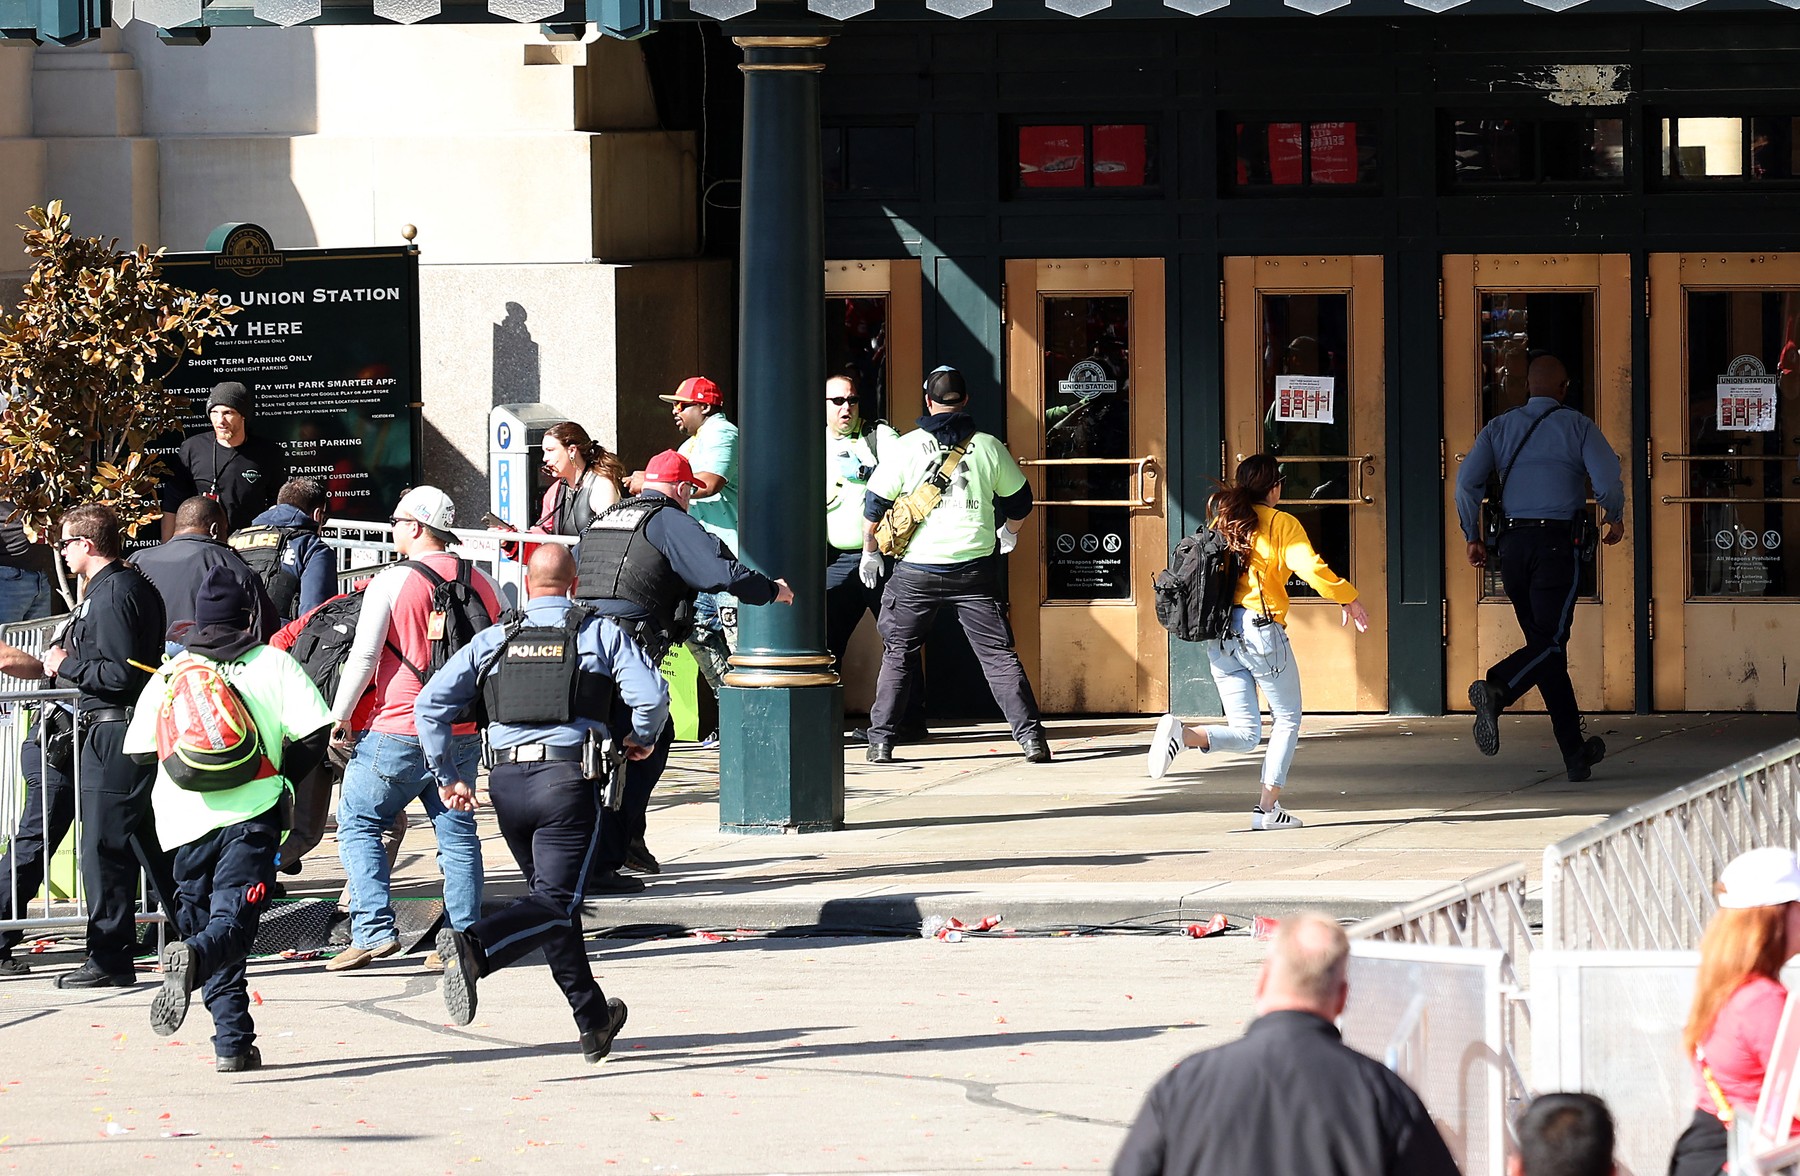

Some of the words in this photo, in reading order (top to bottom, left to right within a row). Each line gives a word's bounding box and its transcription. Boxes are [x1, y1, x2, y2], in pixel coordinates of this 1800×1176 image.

[217, 258, 243, 266] UNION
[245, 256, 280, 265] STATION
[240, 291, 305, 306] UNION
[312, 287, 400, 303] STATION
[247, 321, 303, 336] HERE
[188, 359, 218, 367] SHORT
[219, 357, 245, 365] TERM
[247, 356, 287, 364] PARKING
[288, 354, 313, 362] ONLY
[254, 383, 272, 391] PAY
[298, 381, 325, 389] PARK
[327, 379, 374, 388] SMARTER
[375, 378, 397, 386] APP:
[290, 440, 317, 448] TERM
[320, 438, 363, 447] PARKING
[290, 465, 335, 474] PARKING
[328, 472, 369, 480] CUSTOMERS
[334, 489, 371, 497] MINUTES
[965, 499, 980, 510] INC
[125, 539, 162, 548] PARKIN
[462, 539, 497, 552] TIONAL
[507, 644, 563, 658] POLICE
